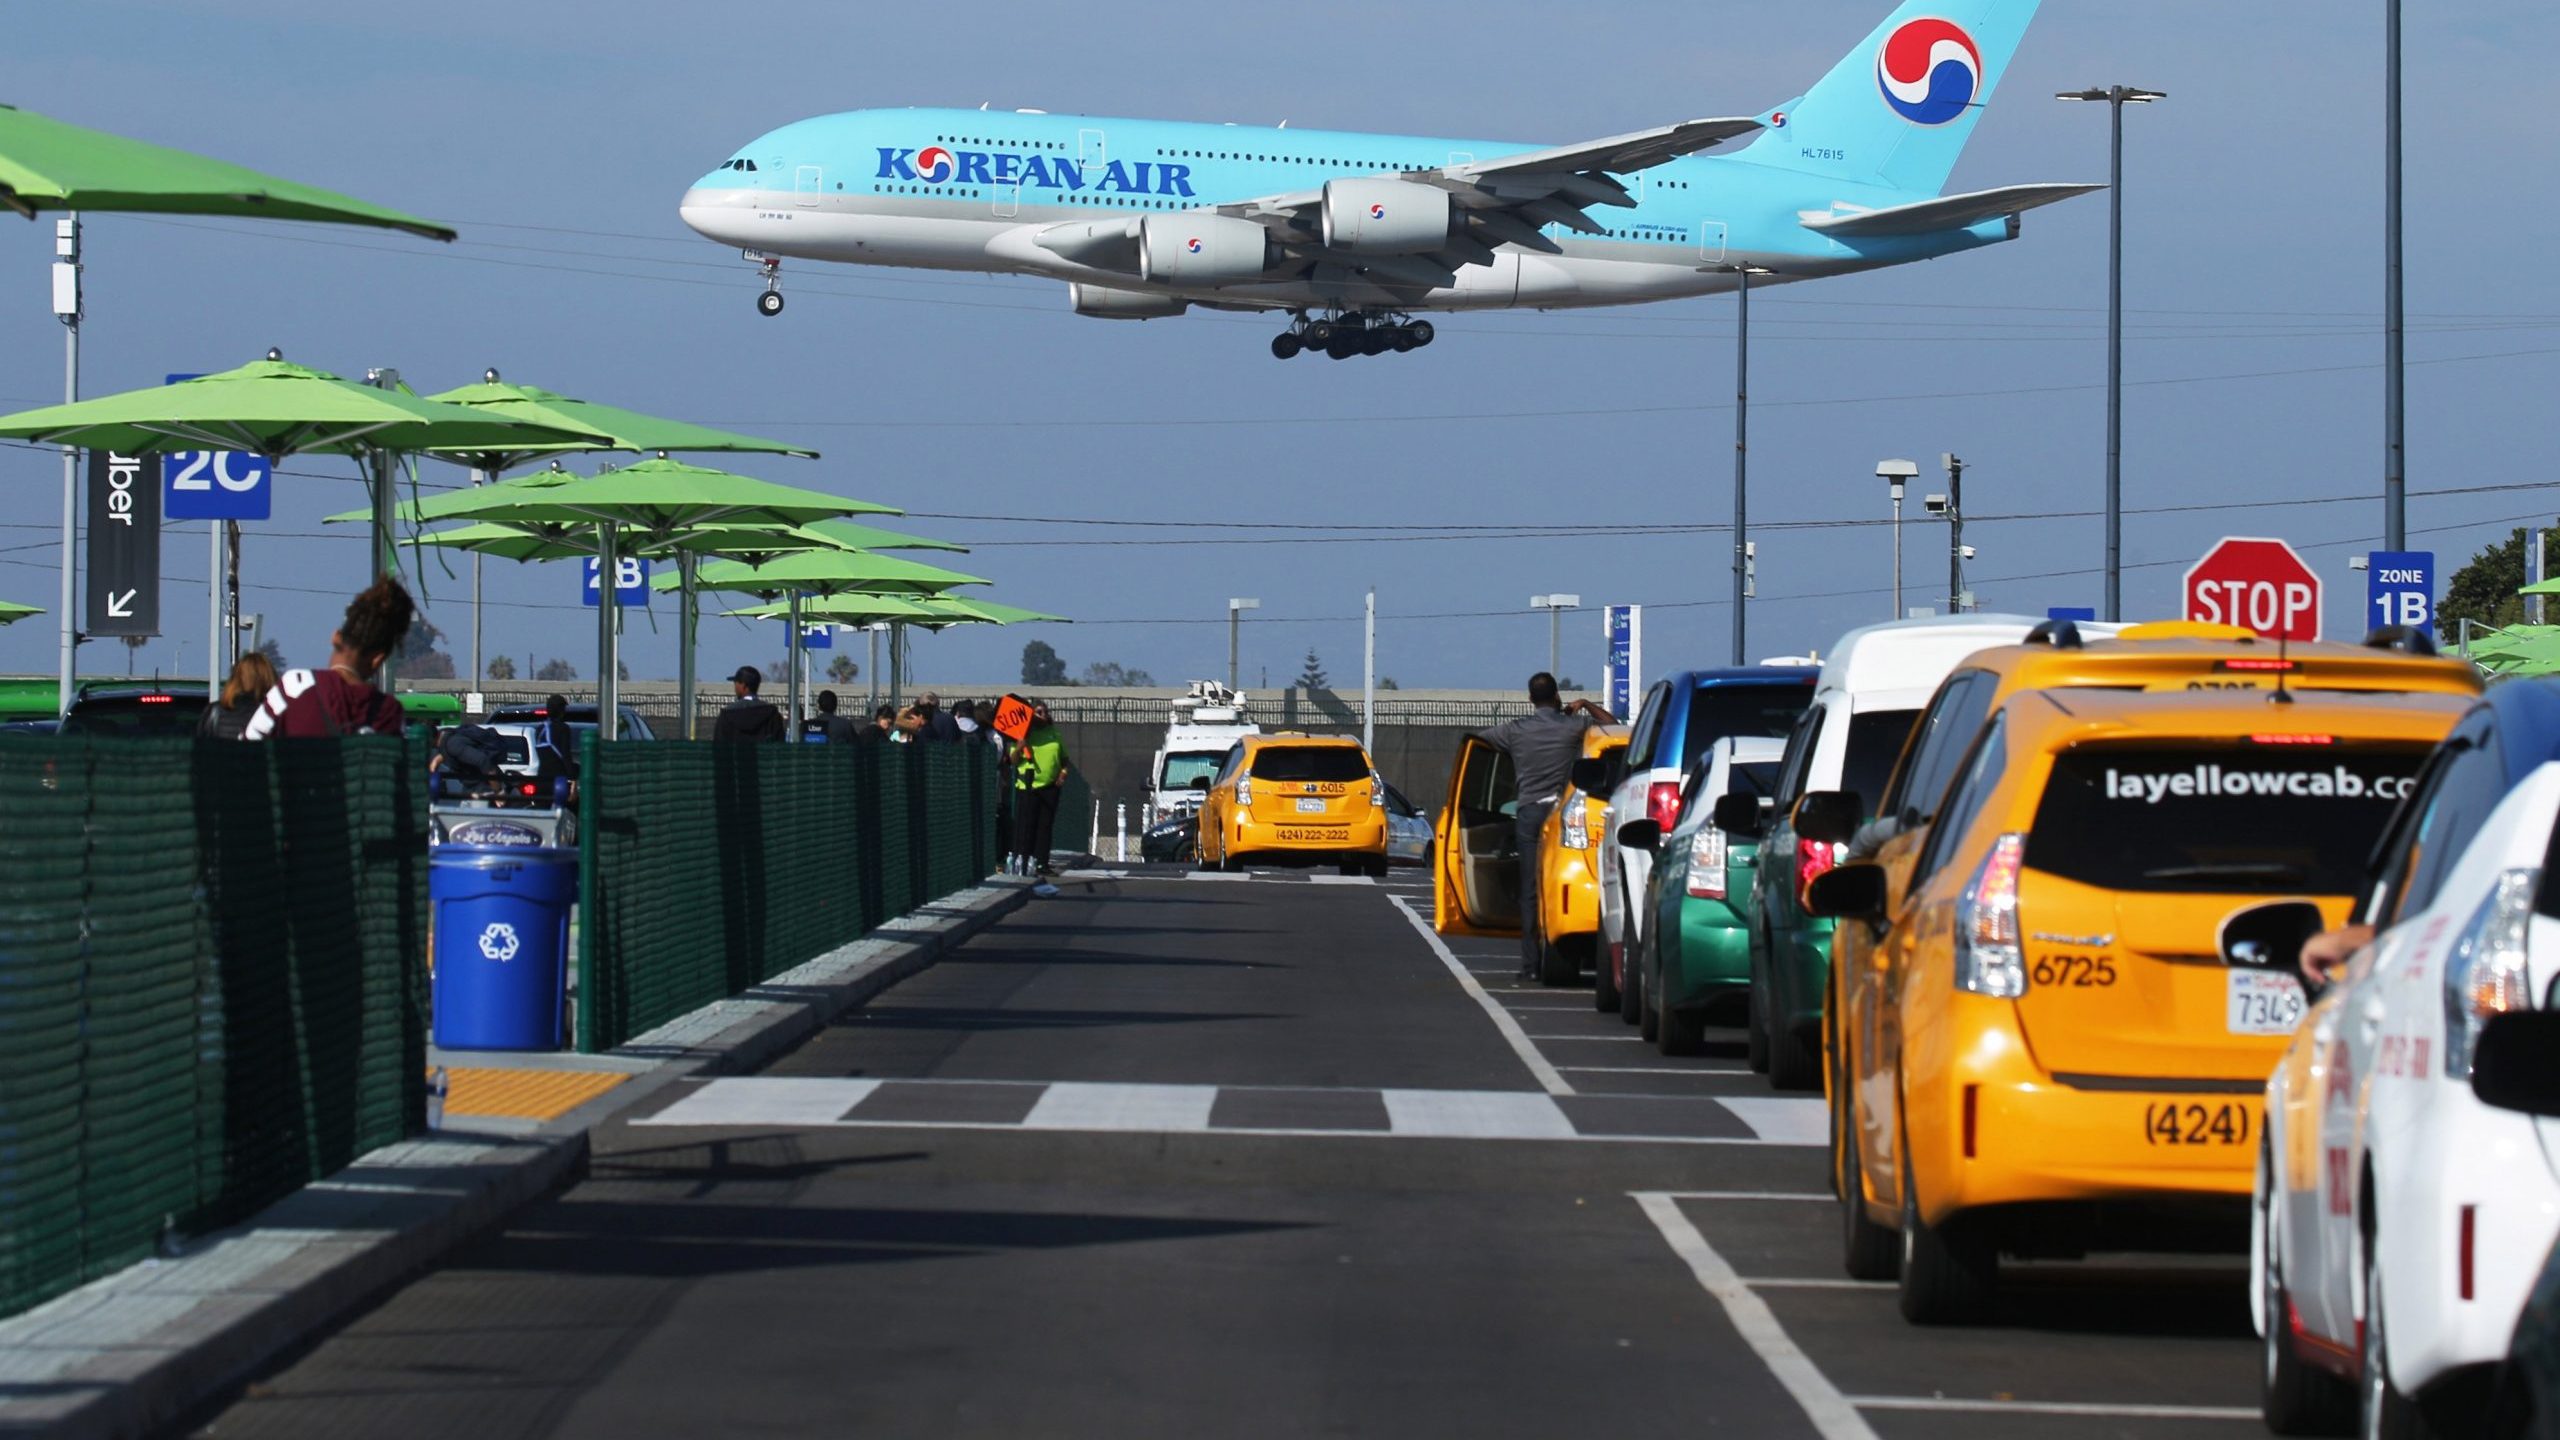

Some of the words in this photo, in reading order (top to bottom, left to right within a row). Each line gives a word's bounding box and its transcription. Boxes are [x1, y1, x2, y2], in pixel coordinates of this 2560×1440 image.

[1801, 147, 1844, 160] HL7615
[875, 146, 1087, 190] KOREAN
[1095, 159, 1196, 197] AIR
[173, 451, 262, 492] 2C
[2379, 569, 2423, 583] ZONE
[2194, 579, 2312, 631] STOP
[2375, 592, 2428, 625] 1B
[997, 705, 1028, 731] SLOW
[1320, 783, 1346, 793] 6015
[1276, 830, 1303, 841] (424)
[1304, 830, 1349, 841] 222-2222
[2033, 956, 2116, 986] 6725
[2146, 1103, 2248, 1146] (424)
